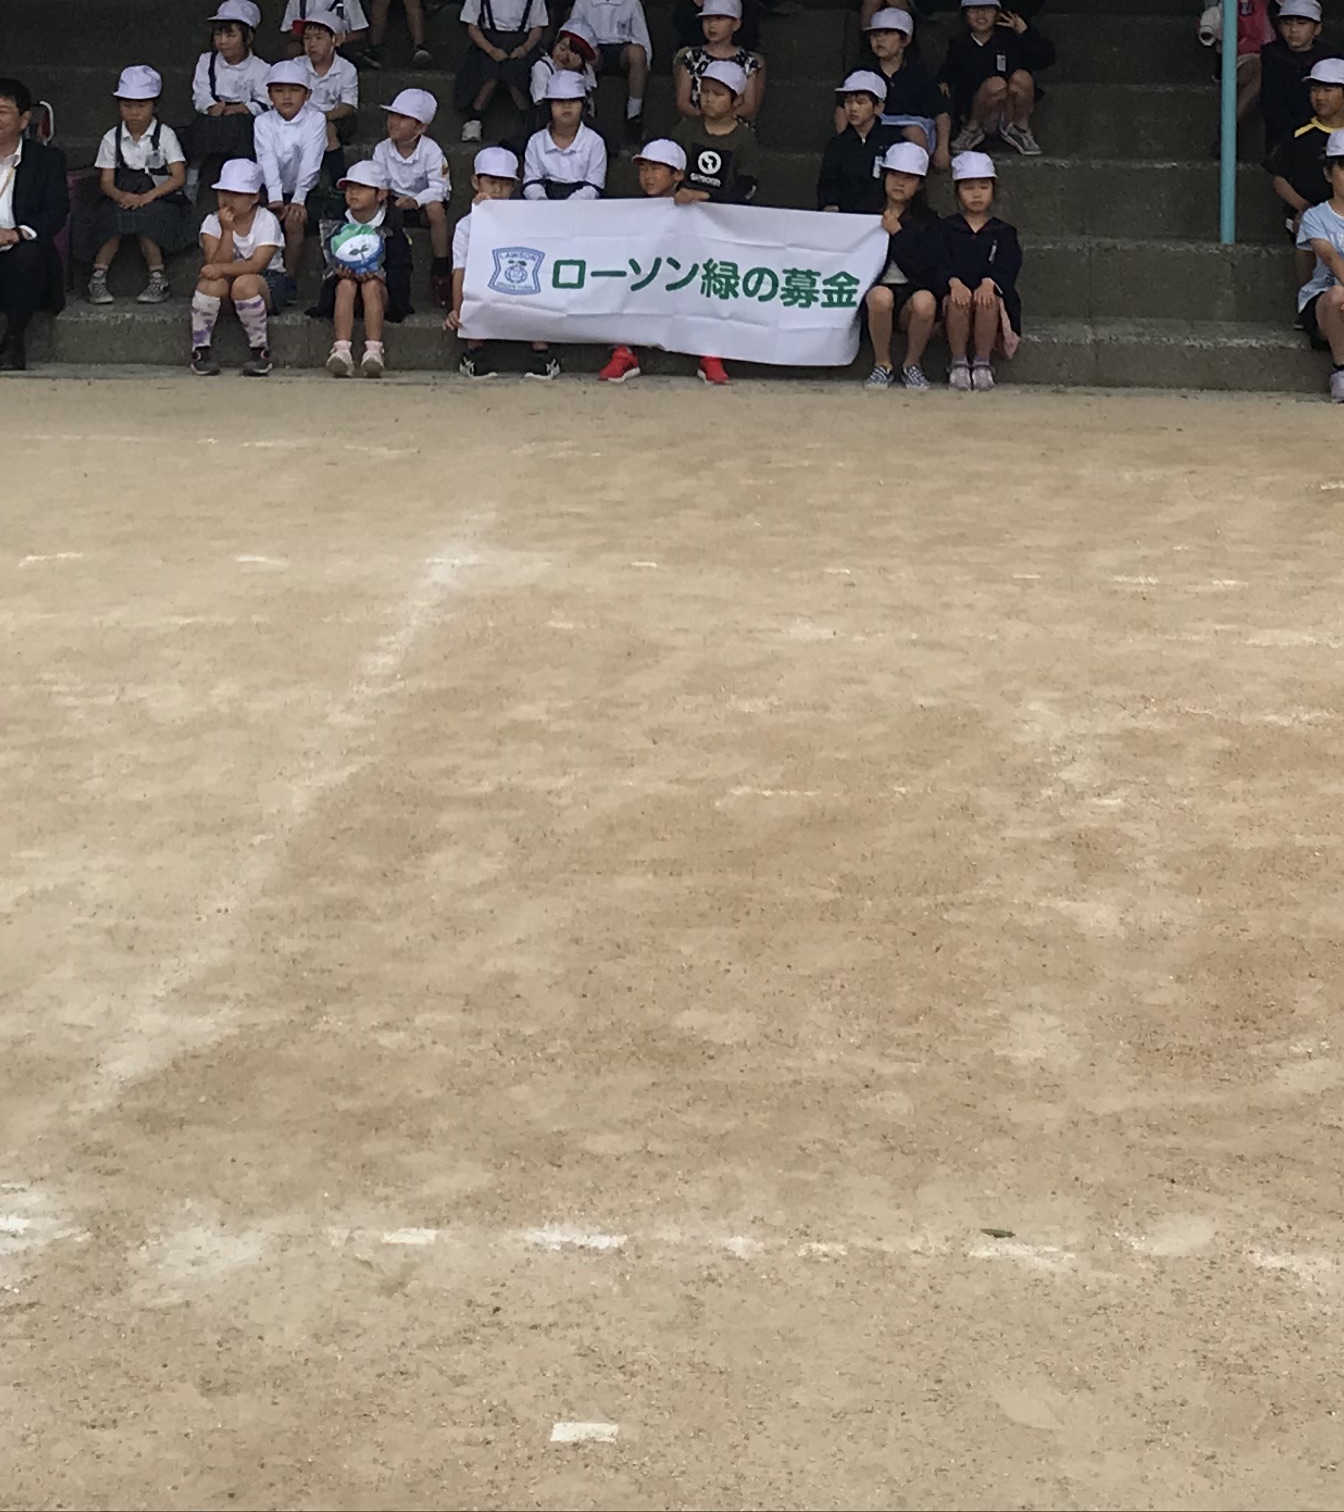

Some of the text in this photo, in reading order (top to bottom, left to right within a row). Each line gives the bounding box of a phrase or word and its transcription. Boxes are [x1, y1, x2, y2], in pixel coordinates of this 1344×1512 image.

[552, 257, 860, 309] ローソン緑の募金
